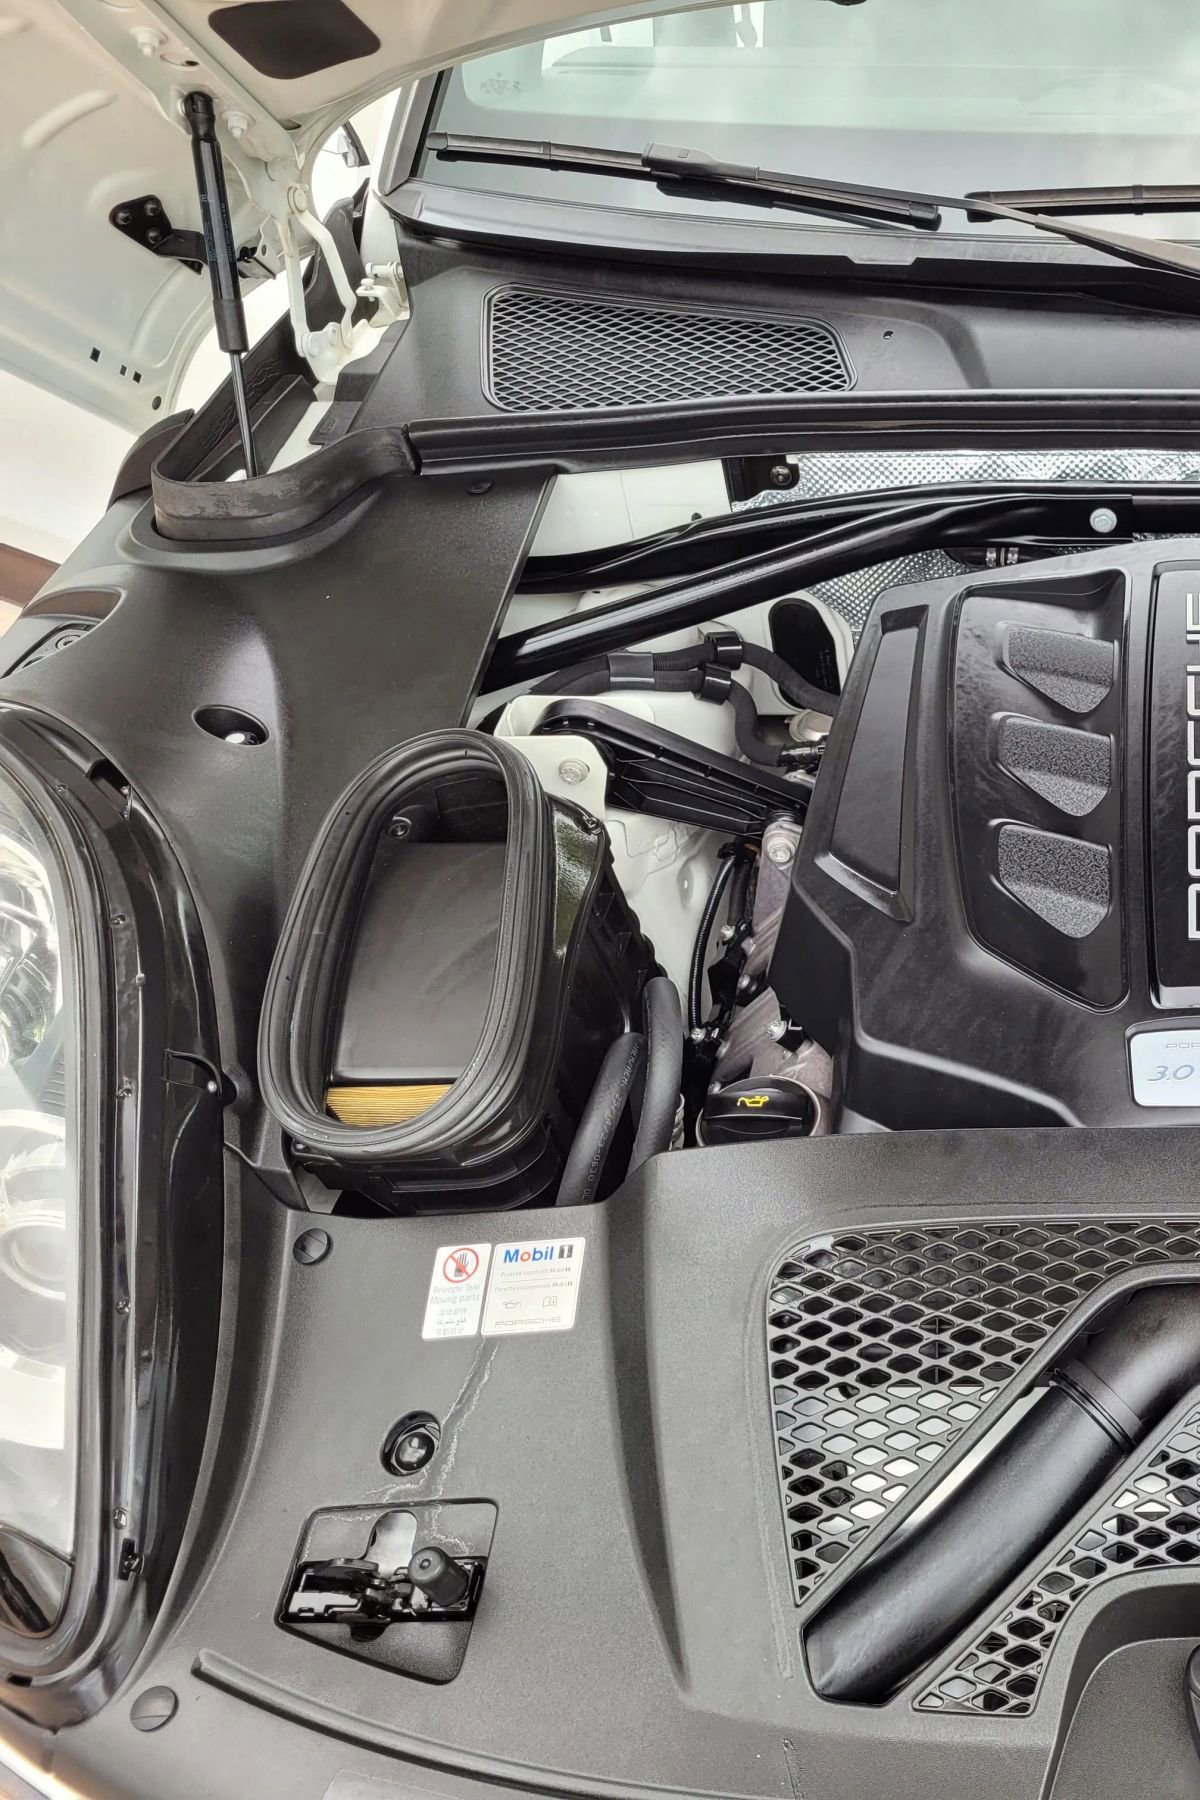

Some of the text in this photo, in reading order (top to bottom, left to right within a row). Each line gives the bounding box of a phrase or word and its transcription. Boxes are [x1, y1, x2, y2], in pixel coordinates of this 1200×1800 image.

[1148, 1064, 1195, 1082] 3.0
[503, 1245, 573, 1263] Mobil 1
[430, 1294, 480, 1305] Moving parts
[495, 1316, 561, 1327] PORSCHE
